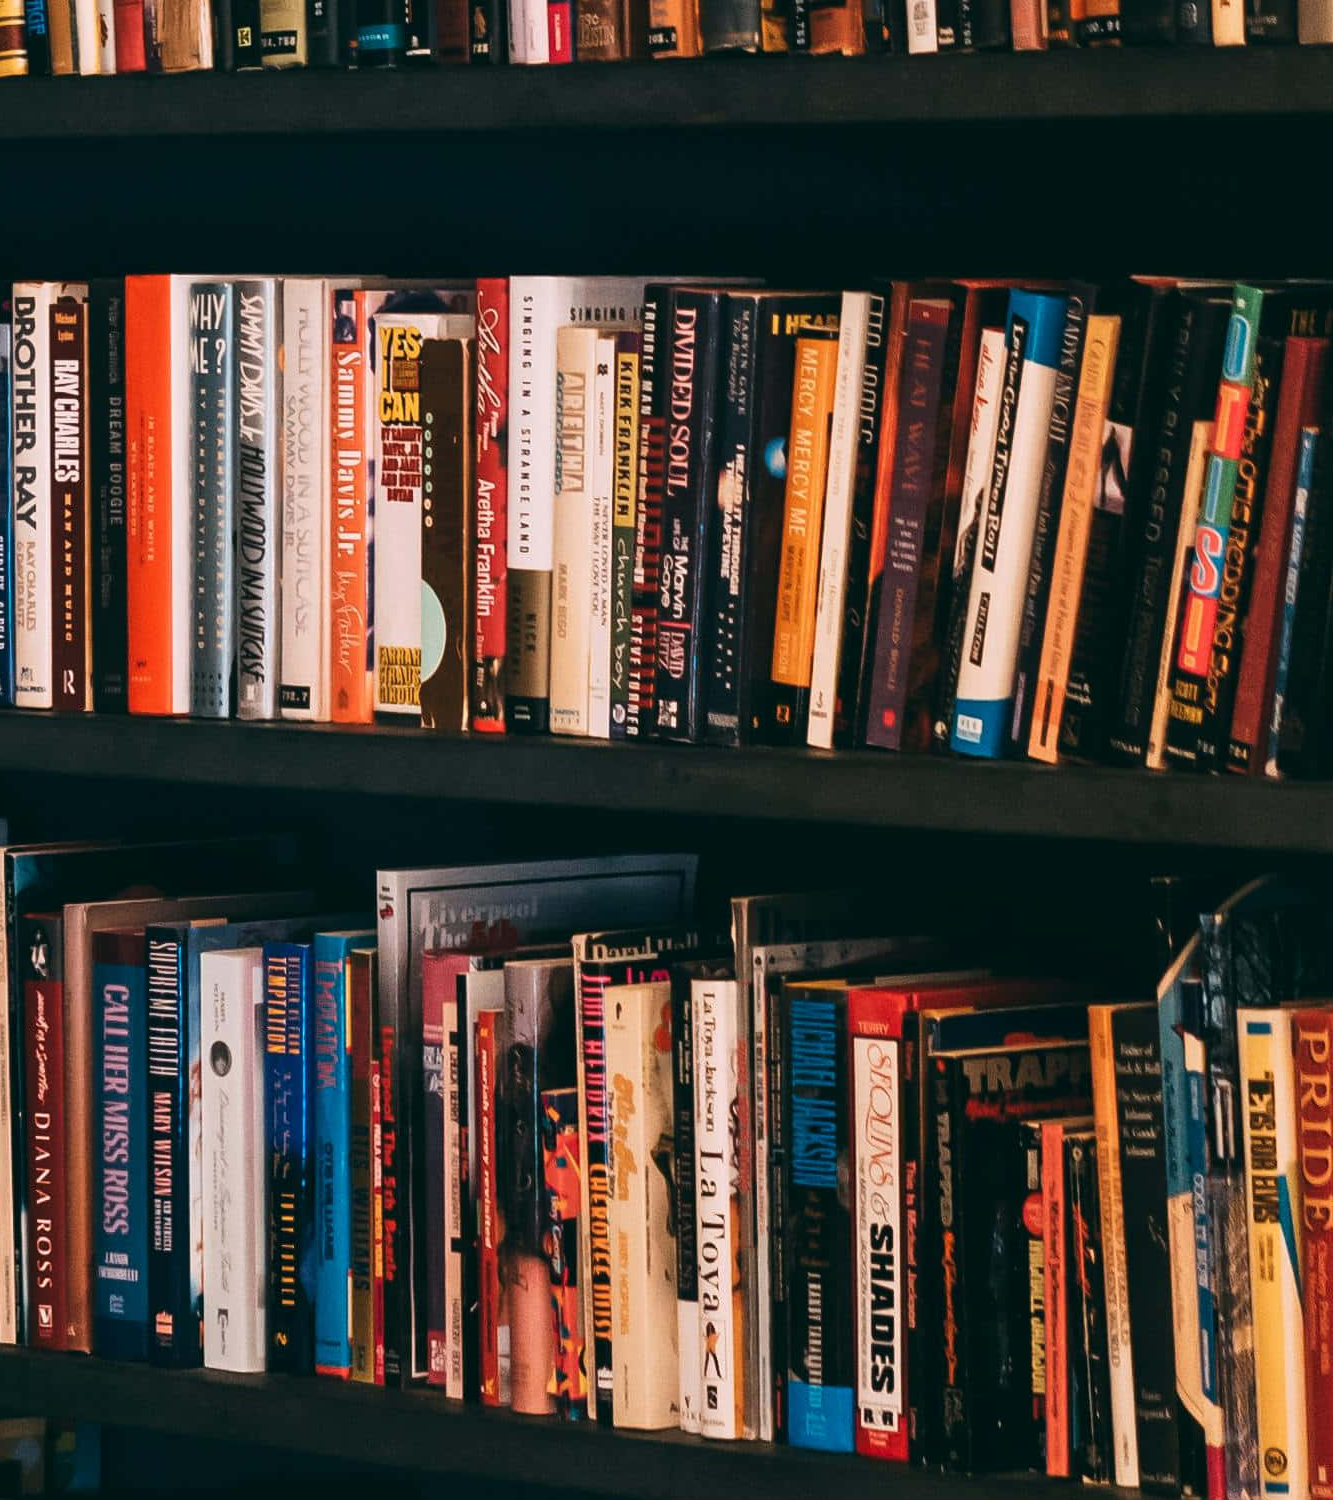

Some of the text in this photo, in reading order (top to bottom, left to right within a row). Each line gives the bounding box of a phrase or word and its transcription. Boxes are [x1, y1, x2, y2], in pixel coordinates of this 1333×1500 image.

[15, 297, 37, 530] BROTHER RAY
[55, 359, 79, 482] RAY CHARLES
[336, 351, 360, 559] Sammy Davis Jr.
[33, 1112, 53, 1289] DIANA ROSS
[699, 1148, 725, 1314] La Toya
[869, 1224, 894, 1394] SHADES
